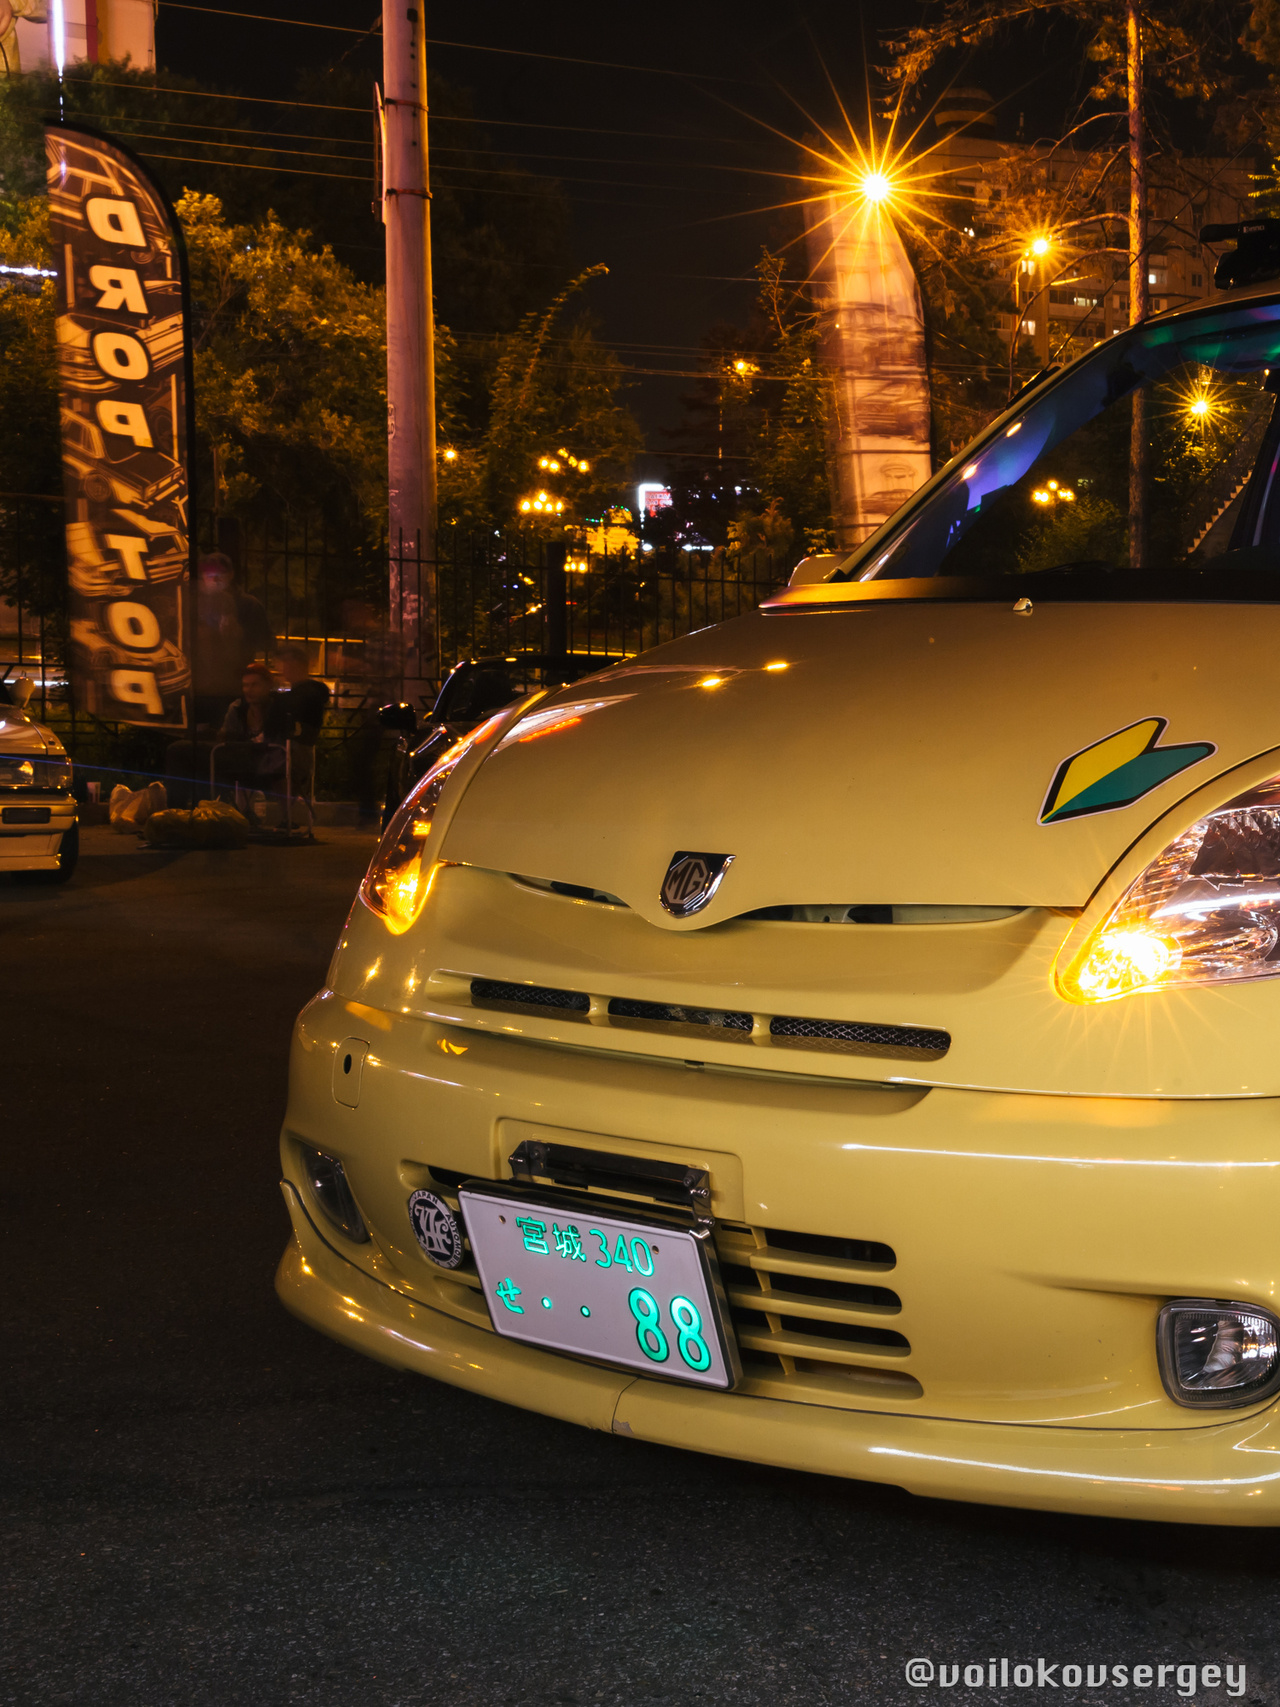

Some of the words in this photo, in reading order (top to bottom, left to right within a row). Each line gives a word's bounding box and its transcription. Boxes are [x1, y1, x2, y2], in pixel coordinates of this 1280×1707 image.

[668, 861, 705, 901] MG
[413, 1191, 439, 1205] JAPAN
[516, 1216, 587, 1262] 宮城
[589, 1229, 655, 1277] 340
[628, 1286, 712, 1373] 88
